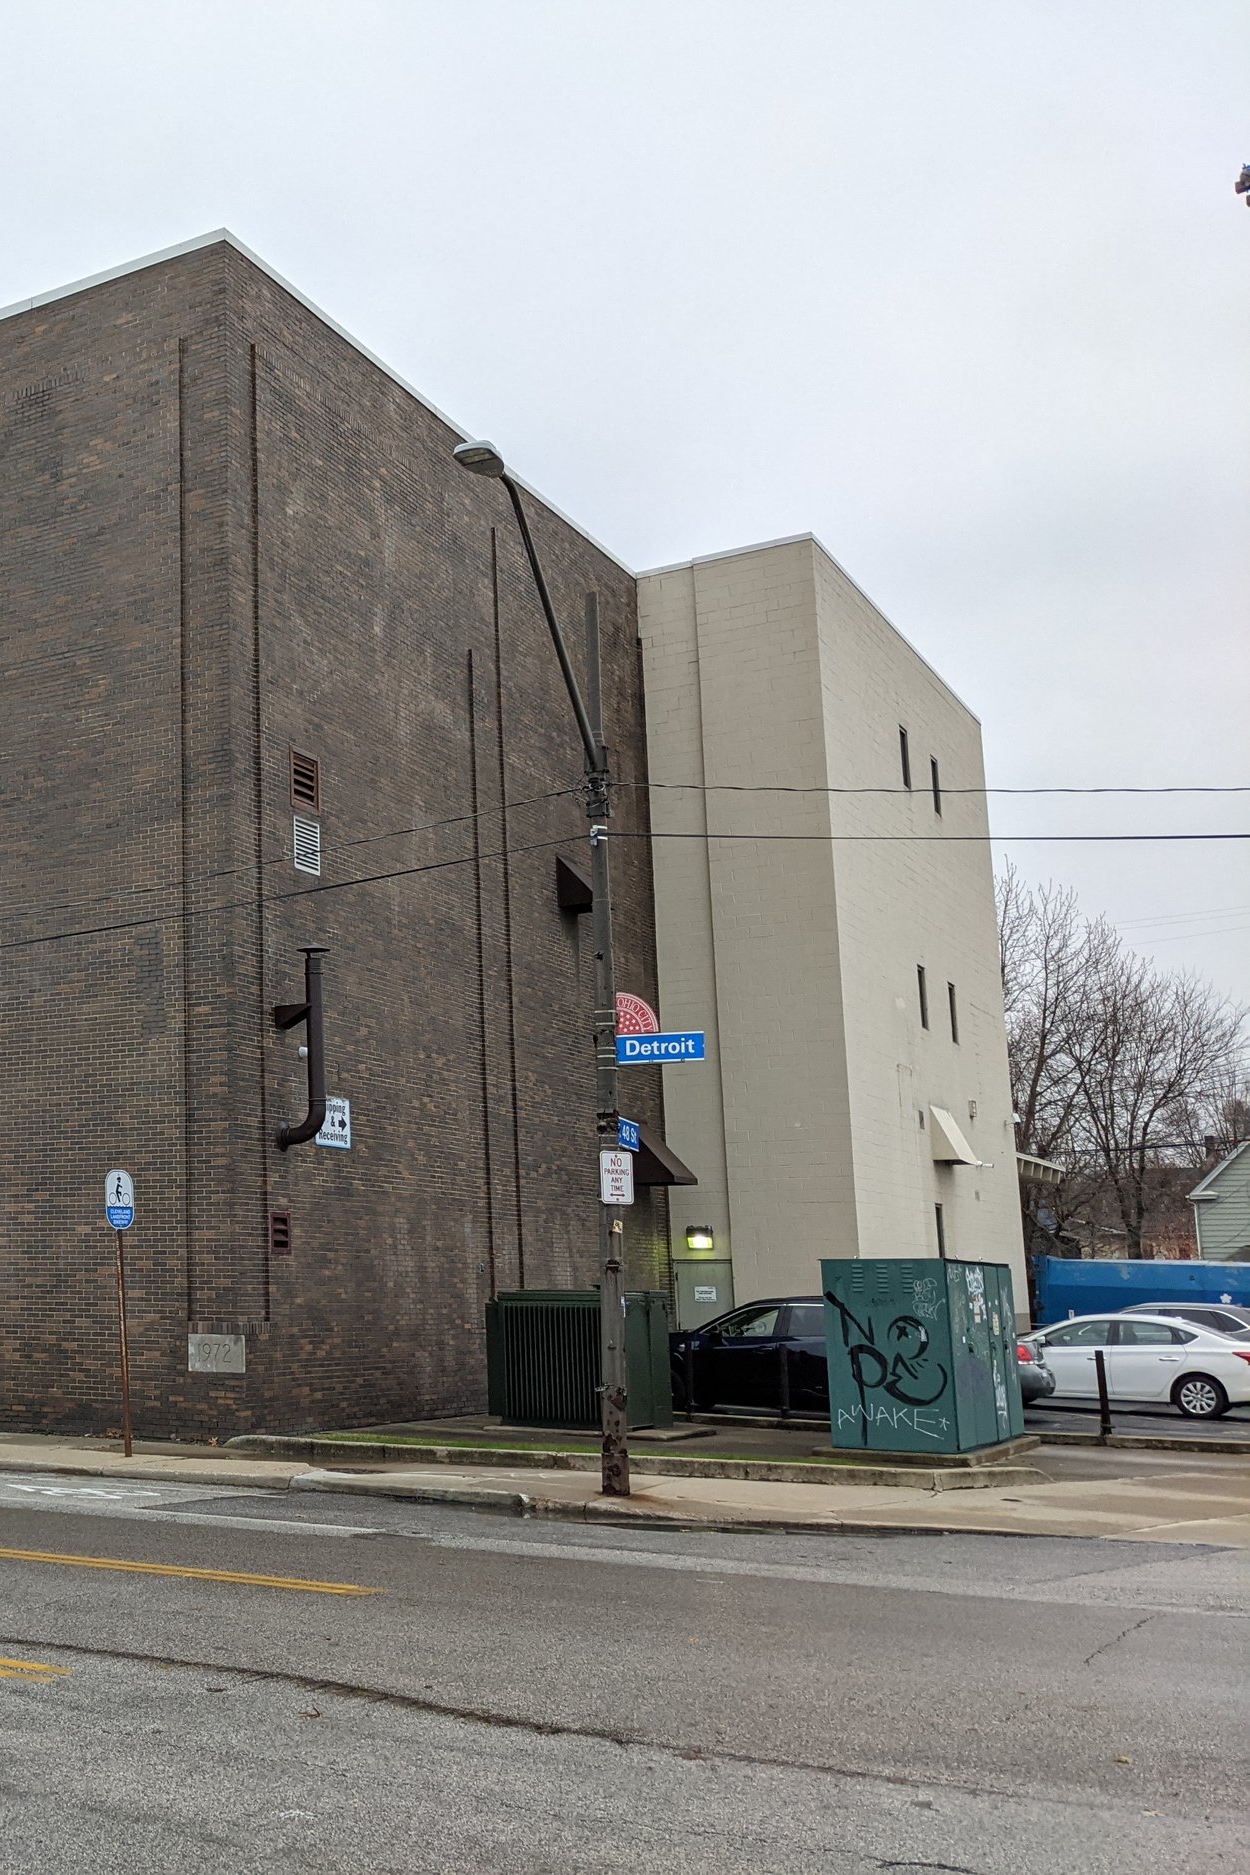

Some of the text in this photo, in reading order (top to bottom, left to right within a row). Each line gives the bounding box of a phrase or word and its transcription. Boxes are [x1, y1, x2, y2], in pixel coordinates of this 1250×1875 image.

[617, 998, 653, 1032] OHIO CITY
[625, 1037, 695, 1056] Detroit
[326, 1101, 346, 1117] ipping
[330, 1115, 336, 1128] &
[318, 1128, 348, 1145] Receiving
[622, 1124, 630, 1142] 48
[630, 1127, 637, 1144] St
[610, 1157, 623, 1167] NO
[603, 1168, 630, 1176] PARKING
[611, 1176, 623, 1184] ANY
[197, 1343, 232, 1363] 1972
